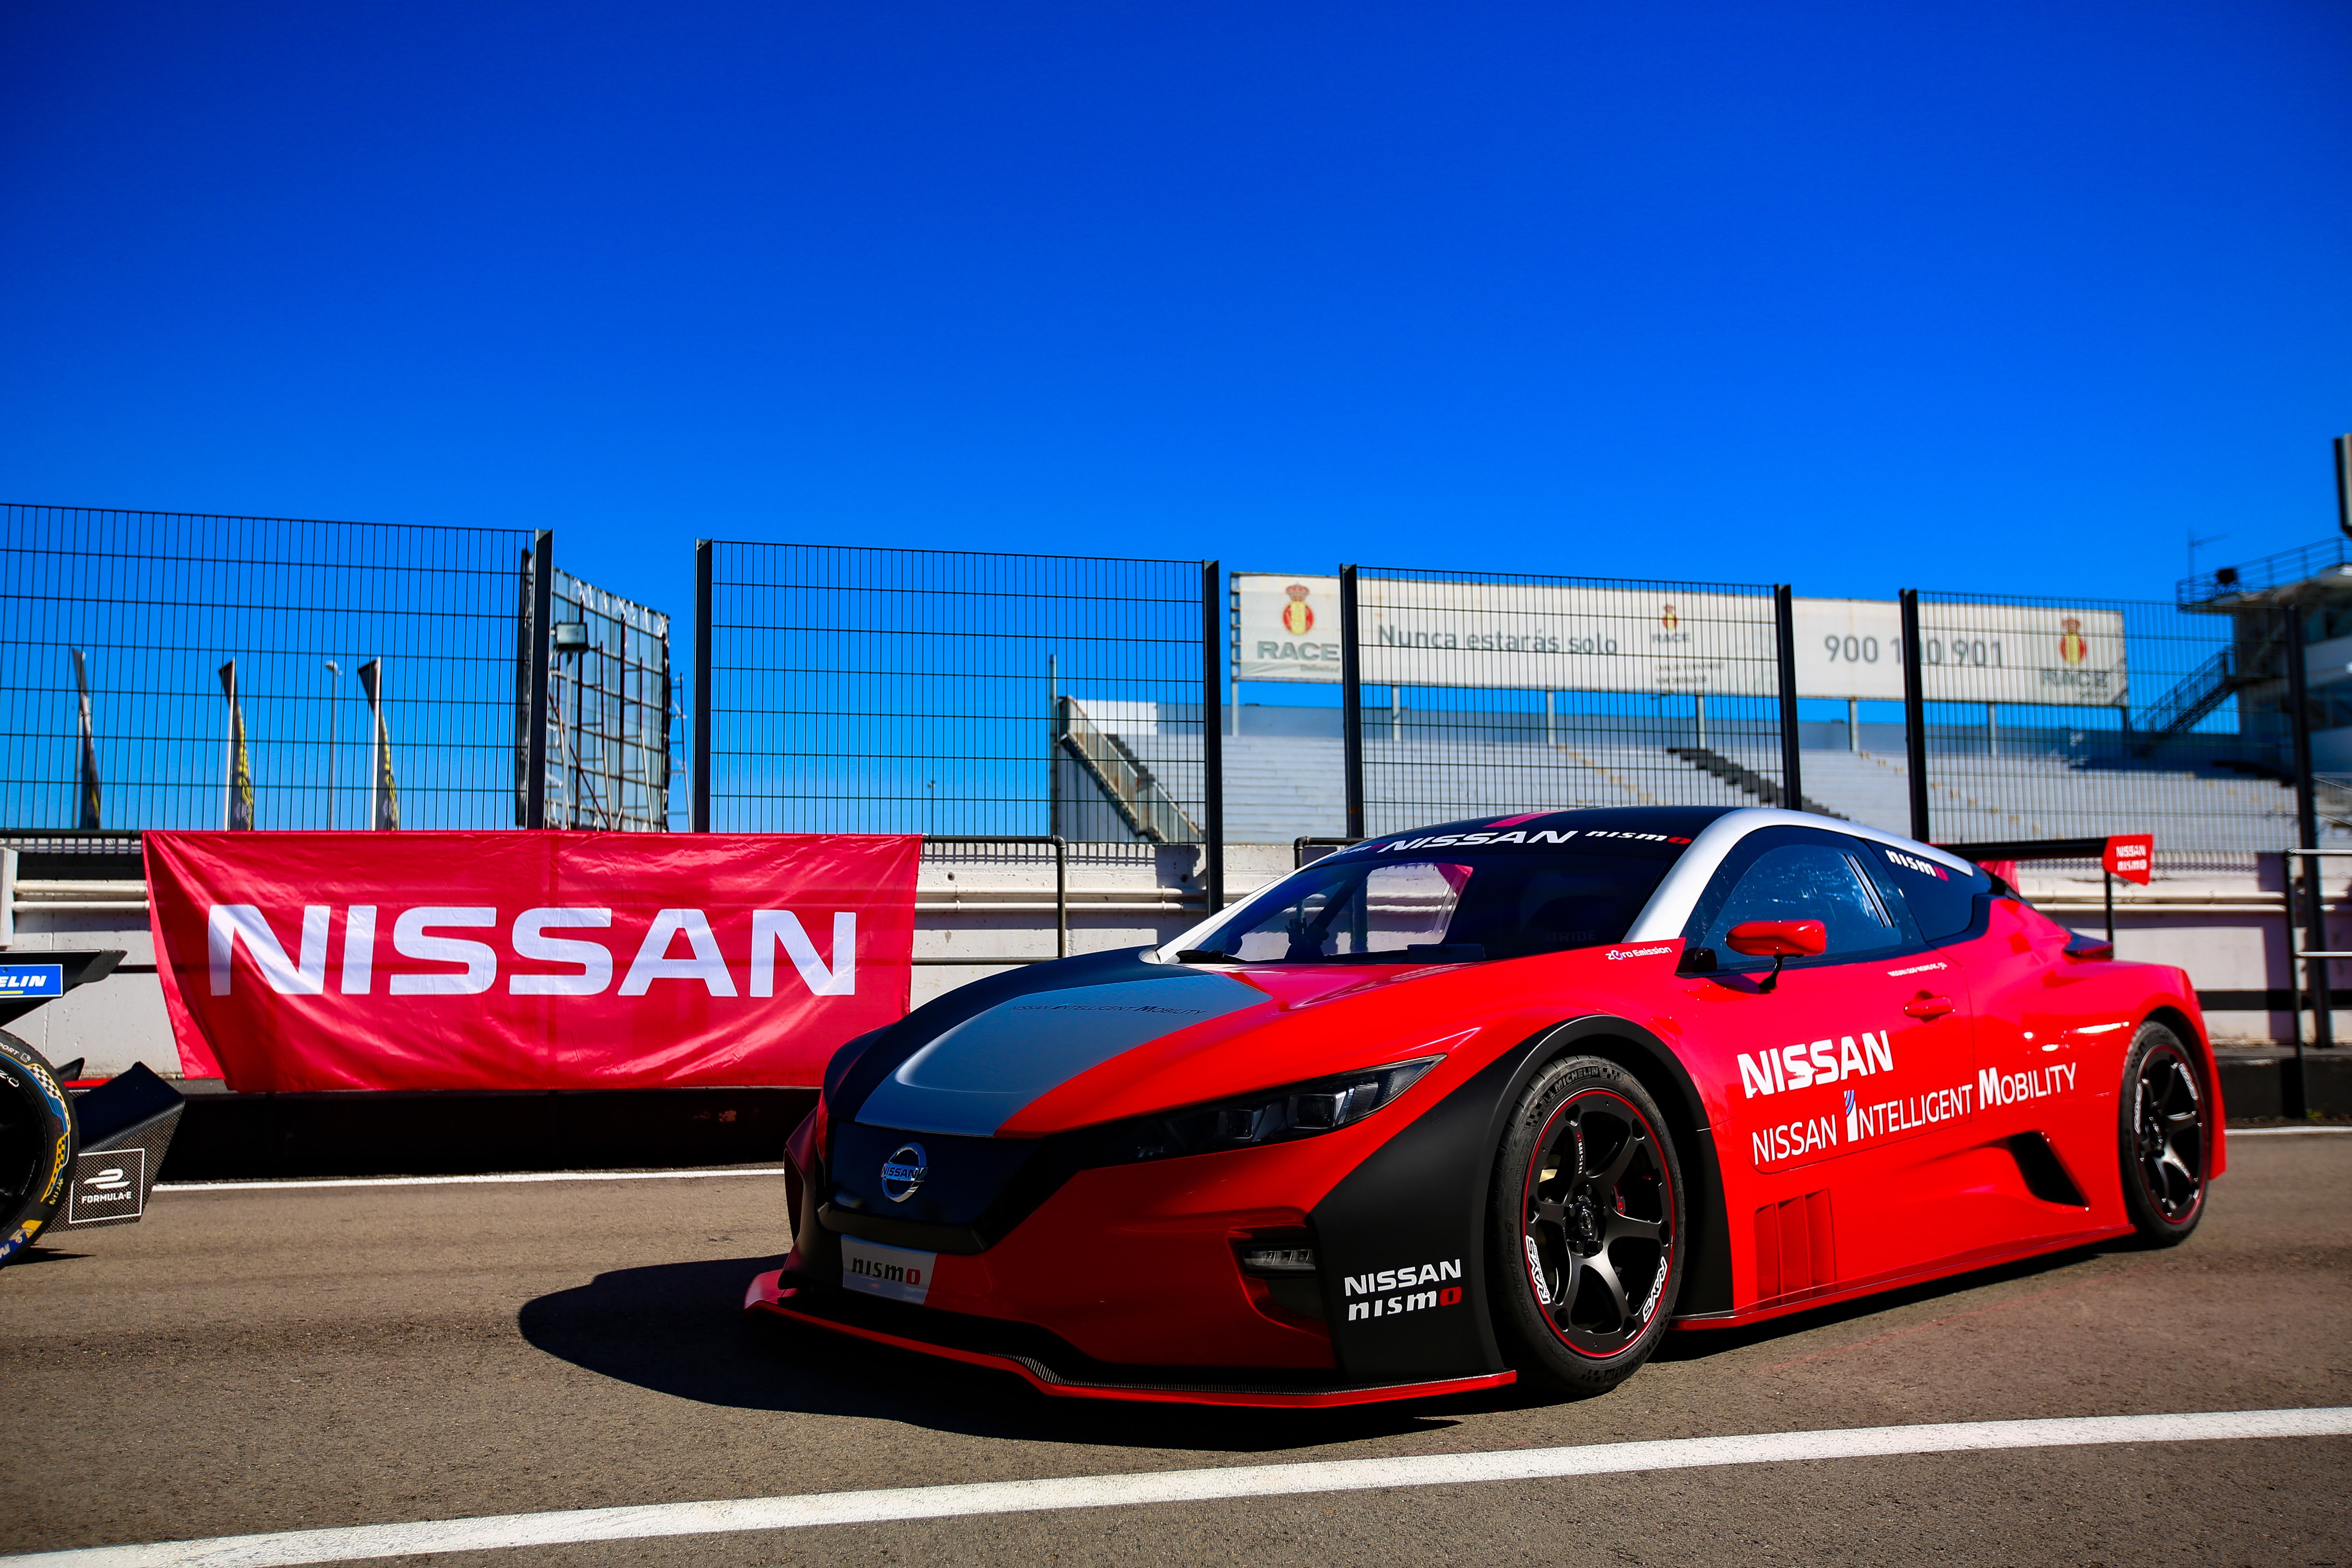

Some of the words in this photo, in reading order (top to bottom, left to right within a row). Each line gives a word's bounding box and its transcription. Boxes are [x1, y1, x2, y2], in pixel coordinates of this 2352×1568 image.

[1258, 640, 1340, 661] RACE
[1379, 624, 1457, 648] Nunca
[1568, 632, 1617, 654] solo
[1824, 635, 1878, 663] 900
[1891, 638, 1941, 664] 10
[1954, 639, 2001, 666] 901
[1377, 831, 1579, 853] NISSAN
[1585, 831, 1693, 844] nismo
[2116, 844, 2146, 858] NISSAN
[1885, 849, 1949, 882] nismo
[2117, 859, 2147, 872] nismo
[208, 904, 855, 997] NISSAN
[1633, 947, 1672, 957] Emission
[1555, 1066, 1599, 1091] MICHELIN
[1737, 1029, 1894, 1099] NISSAN
[1751, 1114, 1838, 1165] NISSAN
[1844, 1089, 1973, 1143] INTELLIGENT
[1979, 1062, 2077, 1110] MOBILITY
[882, 1166, 918, 1178] NISSAN
[852, 1257, 921, 1285] nismo
[1345, 1259, 1461, 1296] NISSAN
[1526, 1236, 1549, 1302] RAYS
[1348, 1286, 1463, 1321] nismo
[1643, 1257, 1667, 1322] RAYS
